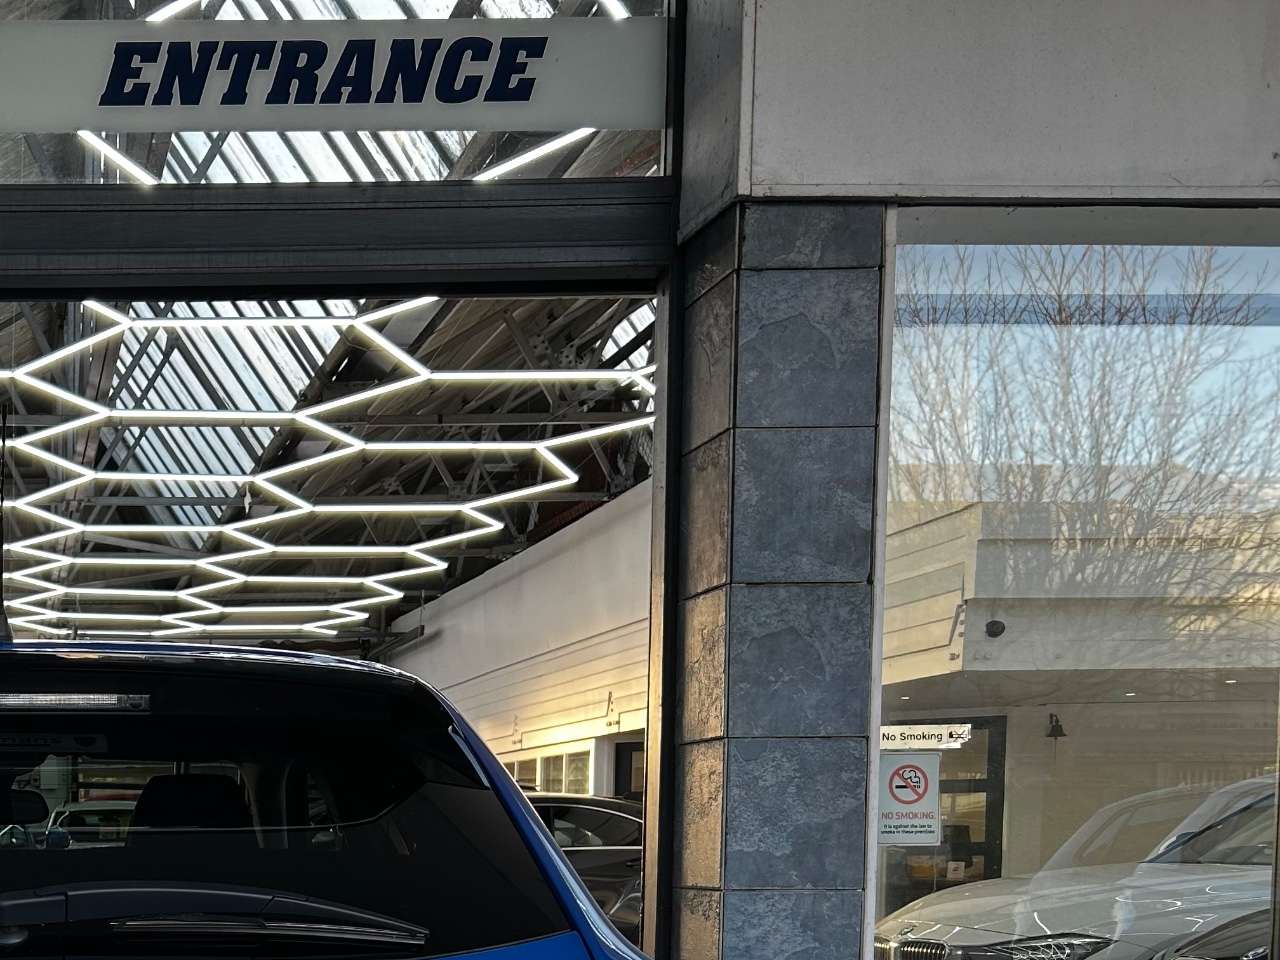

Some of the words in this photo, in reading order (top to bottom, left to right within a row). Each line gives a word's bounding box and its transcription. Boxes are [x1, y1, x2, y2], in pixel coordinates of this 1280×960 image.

[97, 36, 549, 106] ENTRANCE
[882, 732, 896, 741] No
[900, 732, 943, 742] Smoking
[881, 811, 894, 820] NO
